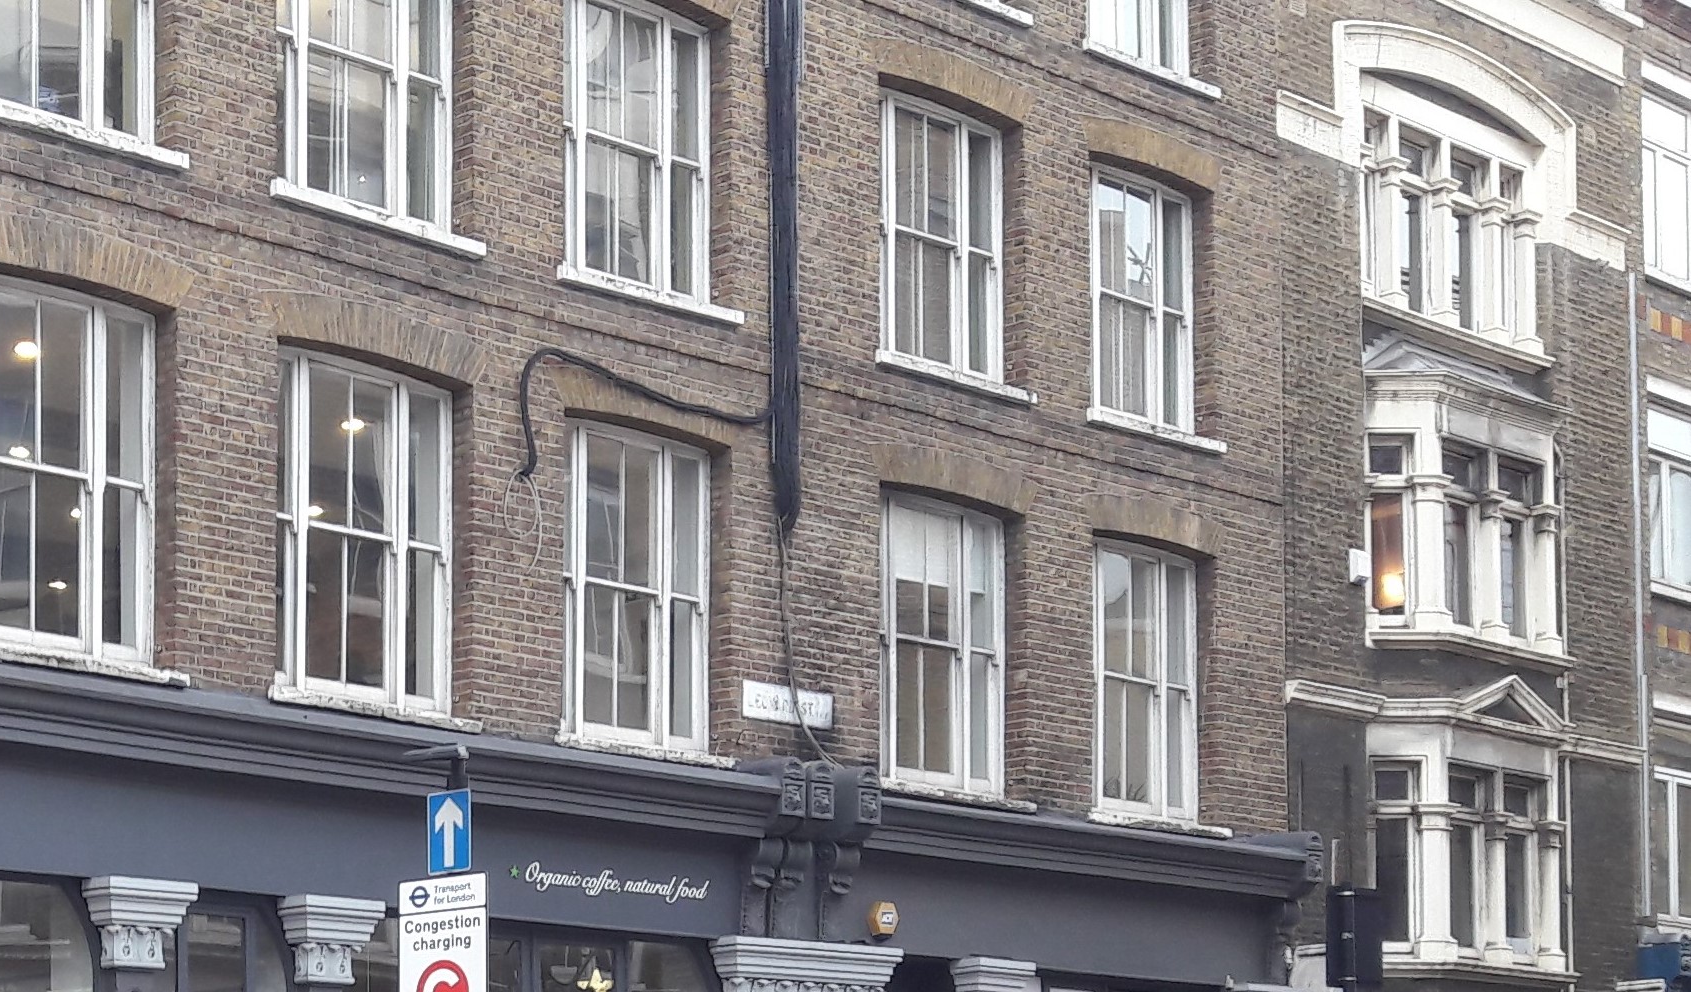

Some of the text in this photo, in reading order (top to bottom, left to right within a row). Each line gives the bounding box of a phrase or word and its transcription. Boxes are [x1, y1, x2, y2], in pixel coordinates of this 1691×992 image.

[433, 882, 472, 894] Transport
[524, 861, 709, 904] Organic coffee, natural food
[433, 893, 476, 905] for London
[404, 914, 481, 935] Congestion
[412, 933, 472, 952] charging
